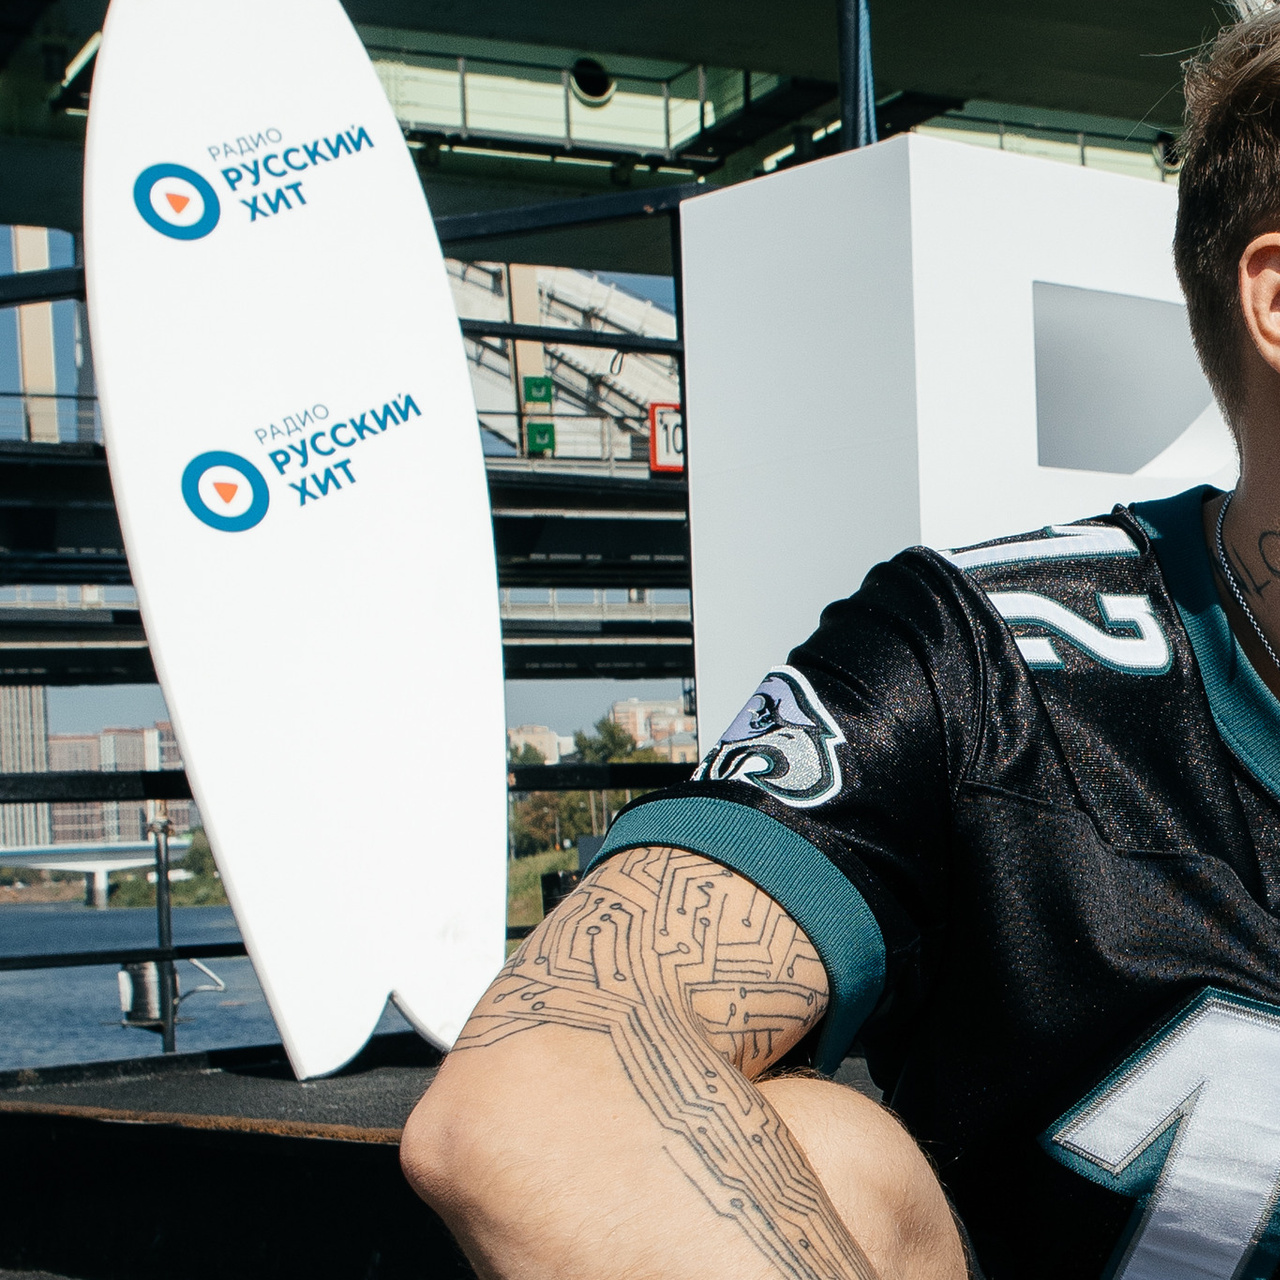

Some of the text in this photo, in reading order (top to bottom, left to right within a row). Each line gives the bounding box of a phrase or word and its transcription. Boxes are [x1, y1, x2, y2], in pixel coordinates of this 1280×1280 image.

[207, 127, 283, 162] РАДИО
[221, 124, 375, 192] РУССКИЙ
[240, 181, 307, 222] ХИТ
[254, 403, 330, 445] РАДИО
[268, 392, 422, 476] РУССКИЙ
[288, 458, 357, 507] ХИТ
